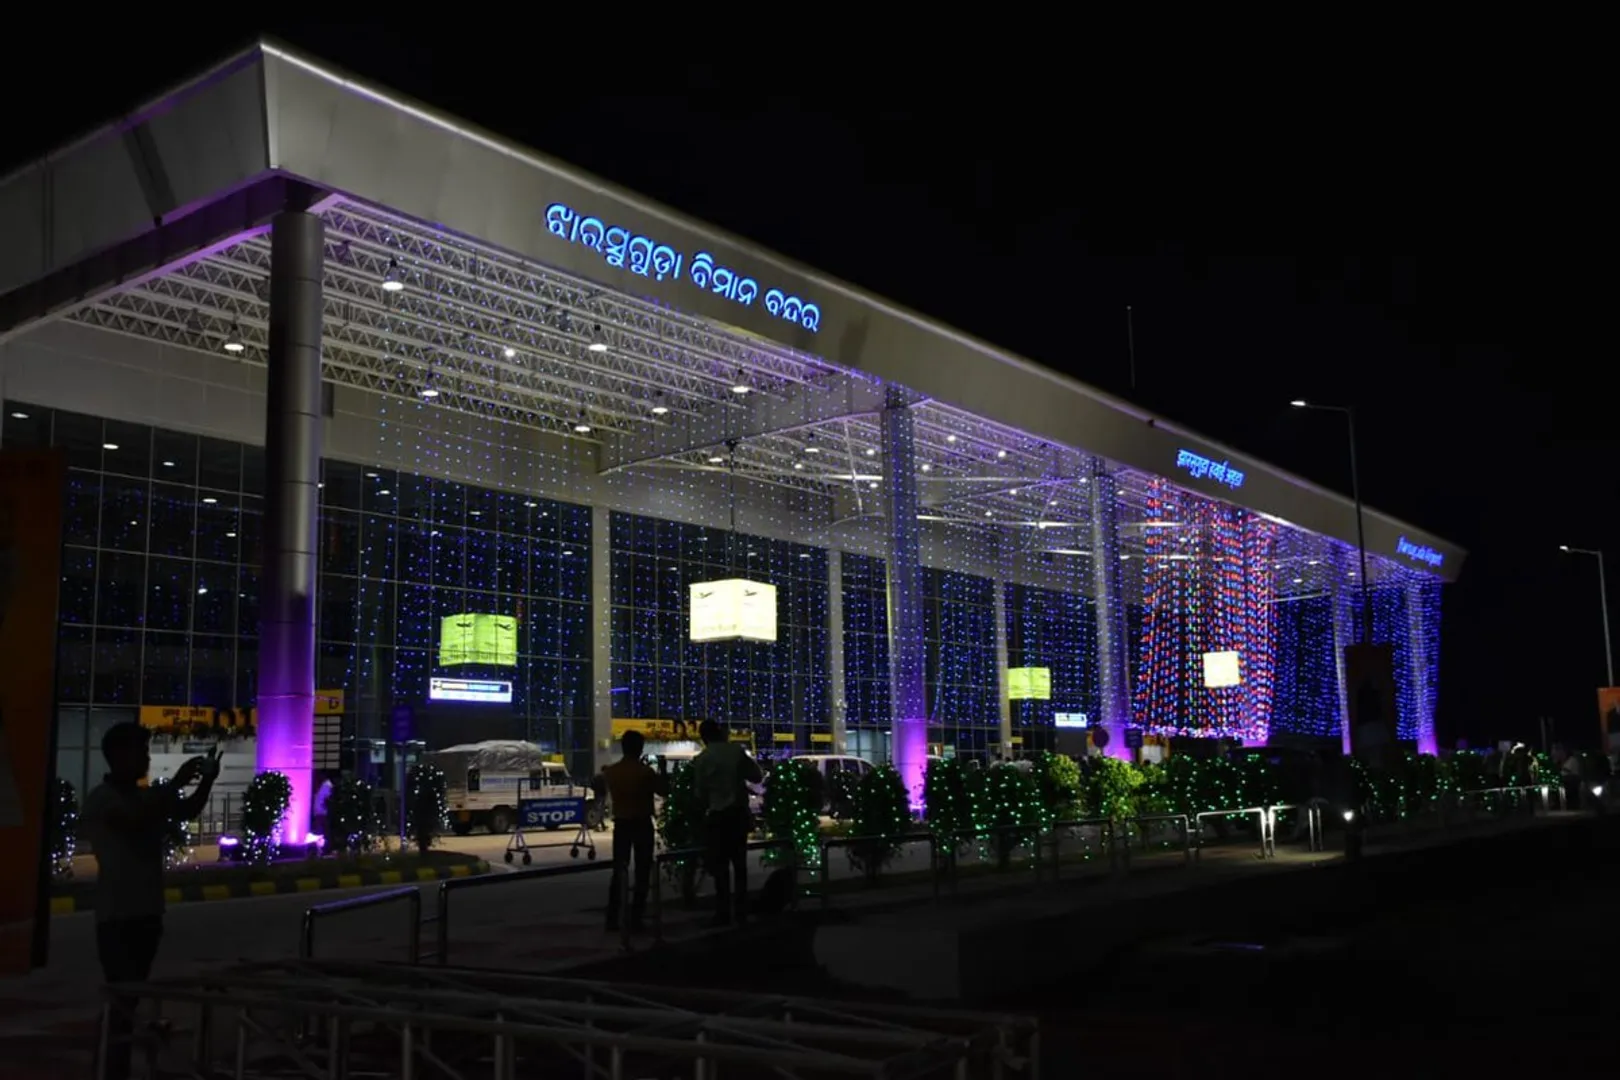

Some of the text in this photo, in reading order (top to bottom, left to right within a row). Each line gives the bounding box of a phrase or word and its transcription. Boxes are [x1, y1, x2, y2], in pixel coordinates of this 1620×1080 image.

[546, 203, 821, 332] ଝାରସୁଗୁଡ଼ା ବିମାନ ବନ୍ଦର
[527, 810, 576, 823] STOP
